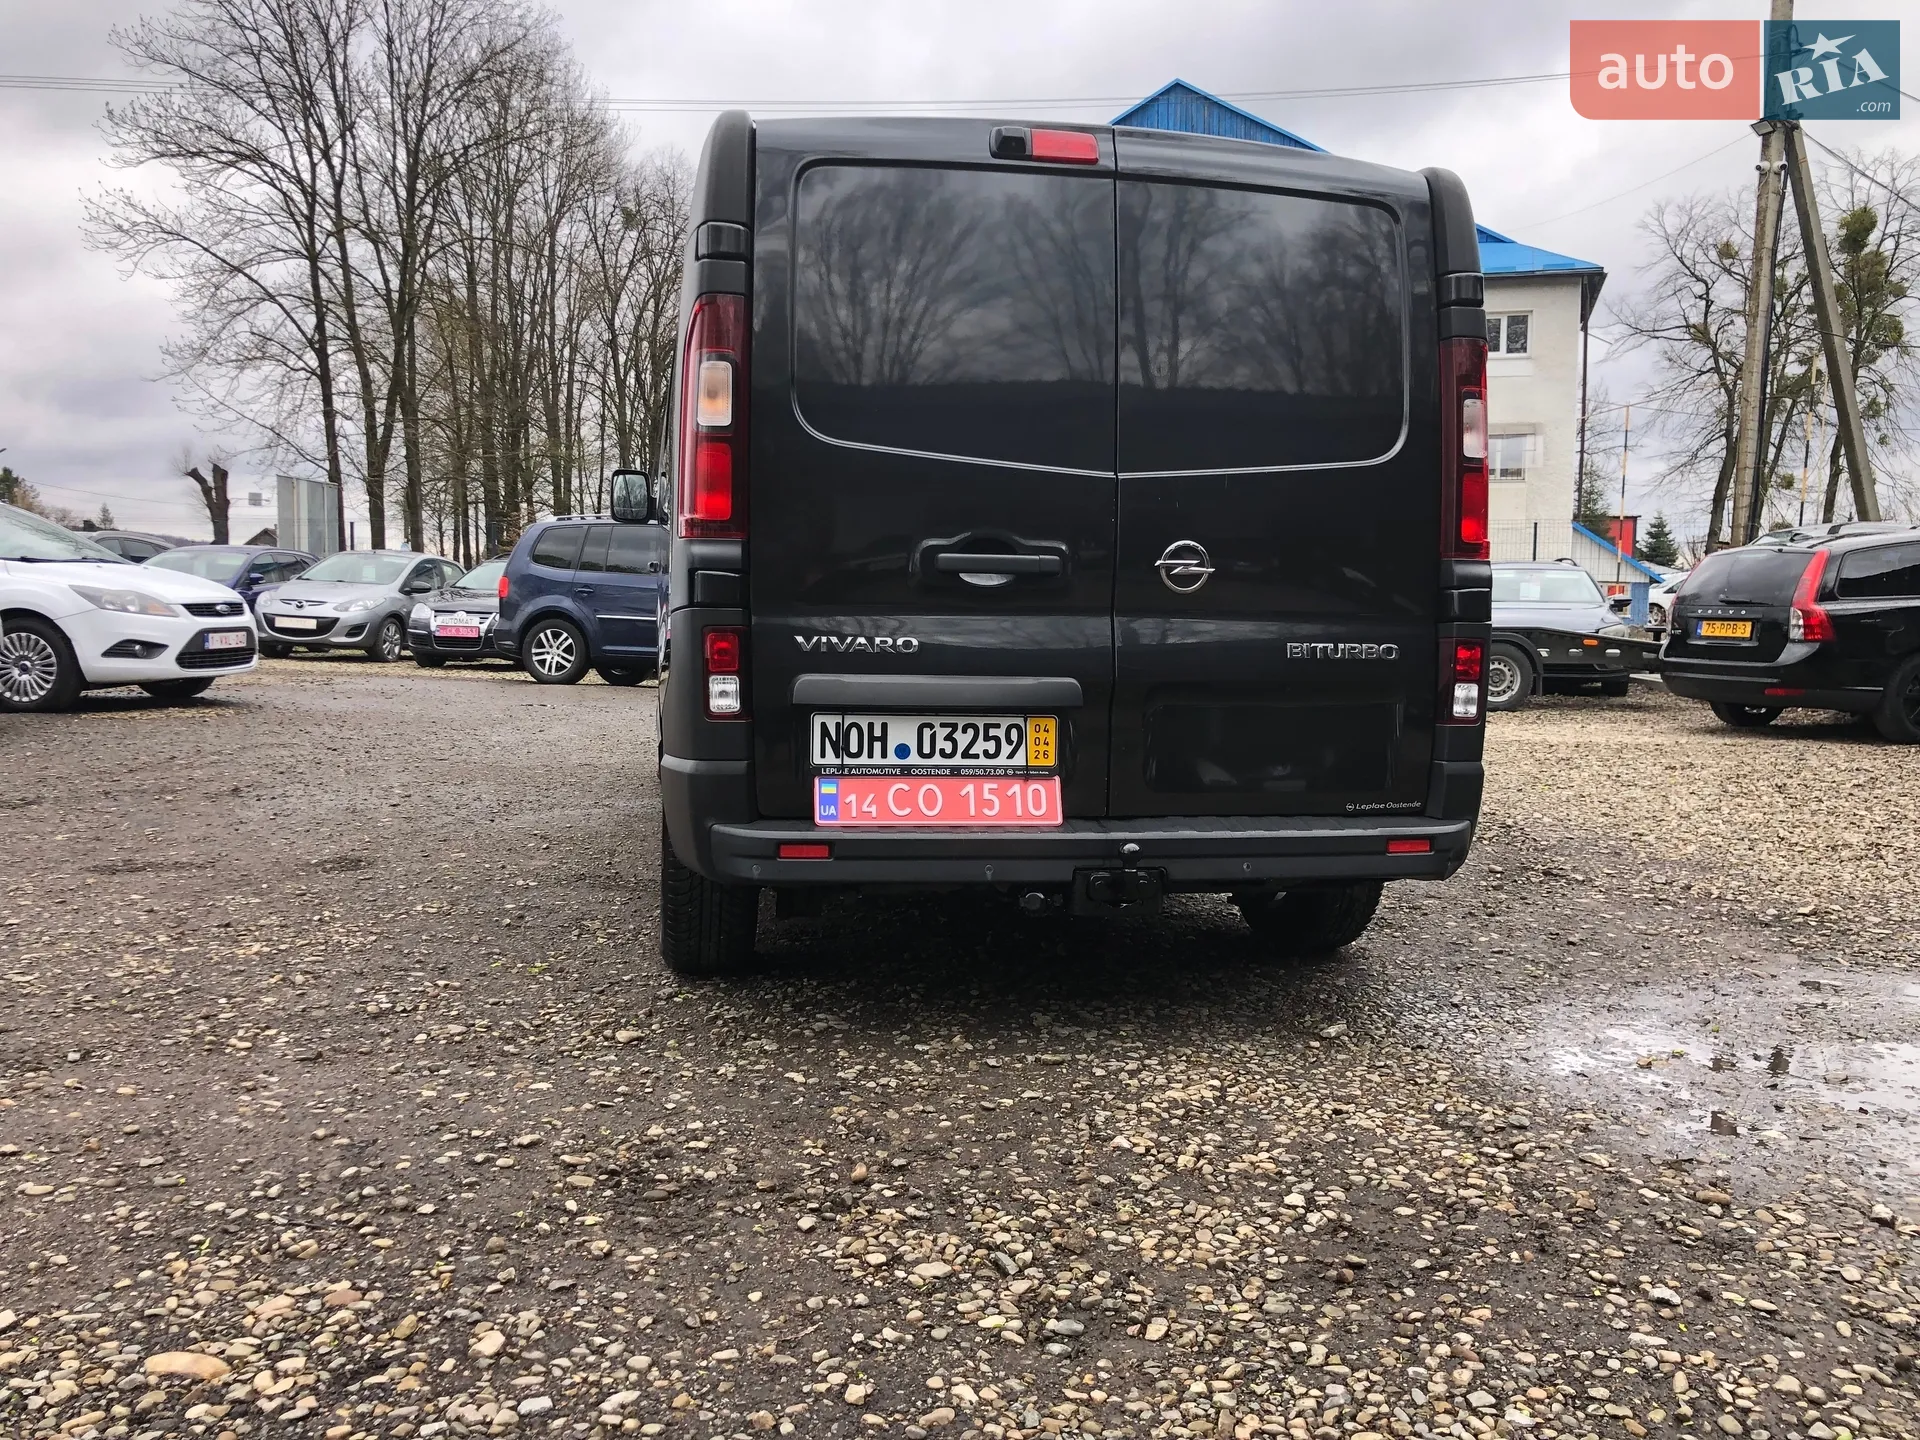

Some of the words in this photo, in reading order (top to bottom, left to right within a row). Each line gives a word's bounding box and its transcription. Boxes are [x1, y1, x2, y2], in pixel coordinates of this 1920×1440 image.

[440, 617, 474, 625] AUTOMAT
[1704, 622, 1748, 635] 75-PPB-3
[794, 635, 920, 654] VIVARO
[1286, 642, 1400, 660] BITURBO
[1034, 723, 1050, 734] 04
[819, 721, 889, 759] NOH
[916, 722, 1025, 760] 03259
[1034, 736, 1050, 747] 04
[1034, 749, 1050, 760] 26
[851, 767, 901, 775] AUTOMOTIVE
[910, 768, 951, 776] OOSTENDE
[960, 768, 1005, 776] 059/50.73.00
[844, 793, 877, 818] 14
[887, 783, 943, 817] CO
[959, 783, 1047, 817] 1510
[820, 805, 837, 816] UA
